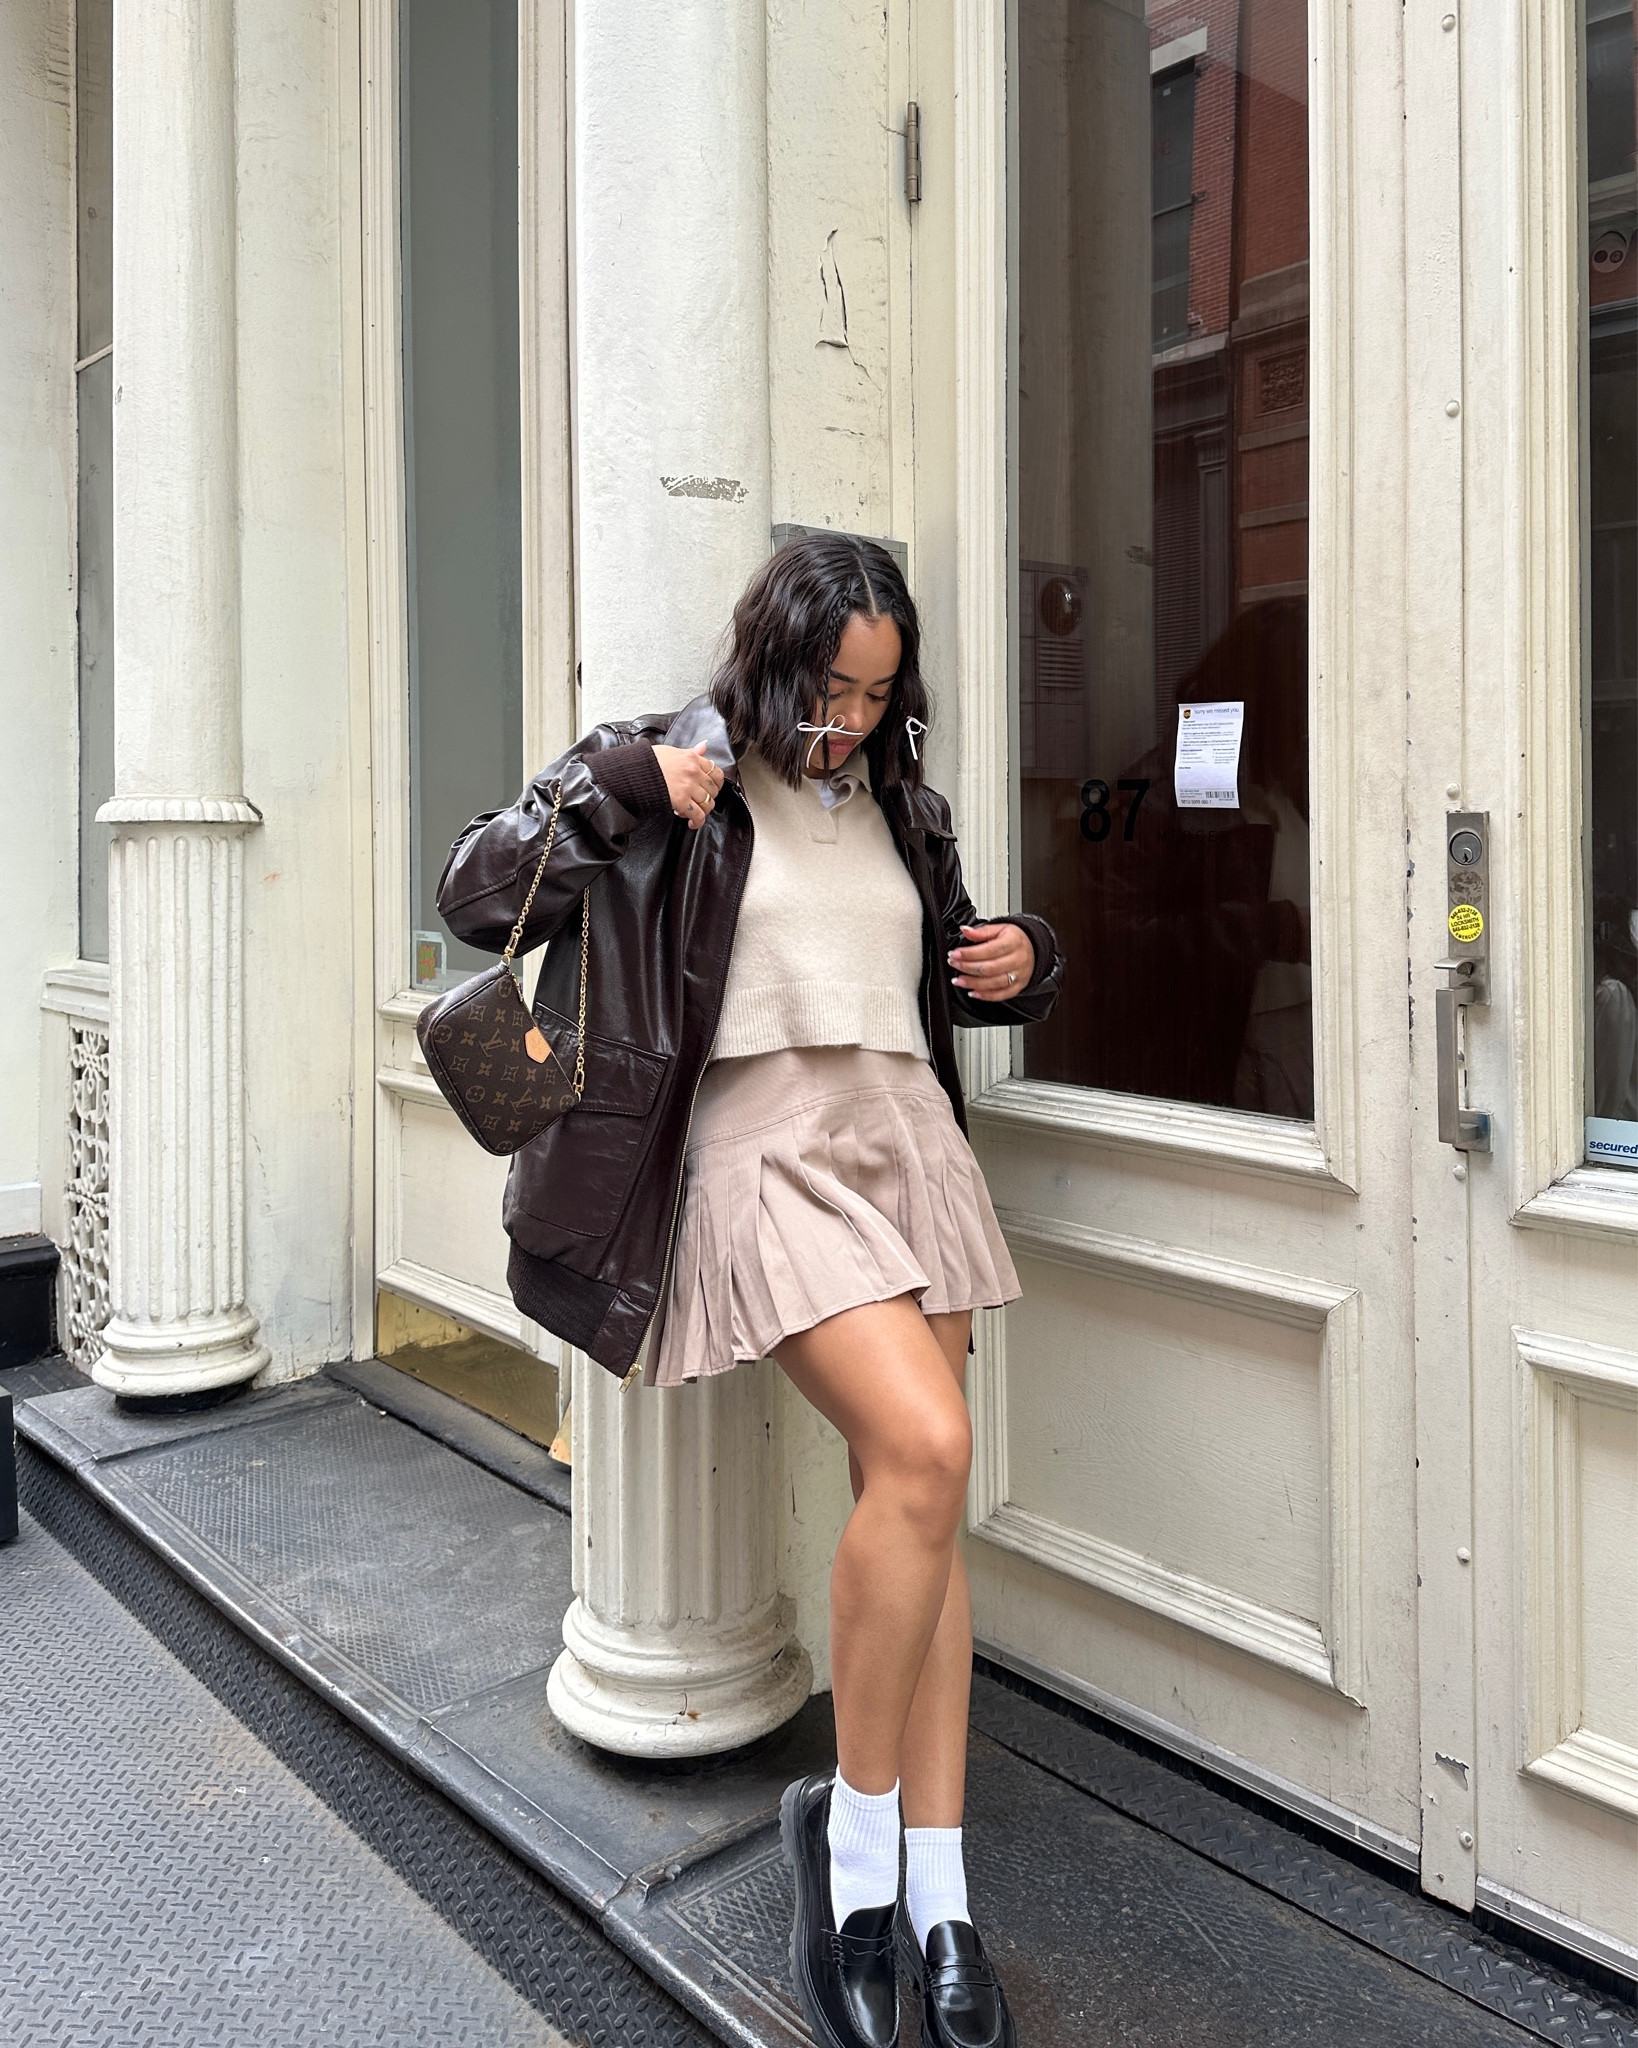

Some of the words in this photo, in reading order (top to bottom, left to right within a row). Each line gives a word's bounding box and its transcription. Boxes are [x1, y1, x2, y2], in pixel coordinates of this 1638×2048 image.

[1080, 778, 1151, 842] 87
[1450, 916, 1480, 928] LOCKSMITH
[1455, 927, 1482, 940] EMERGENCY
[1588, 1140, 1638, 1154] secured
